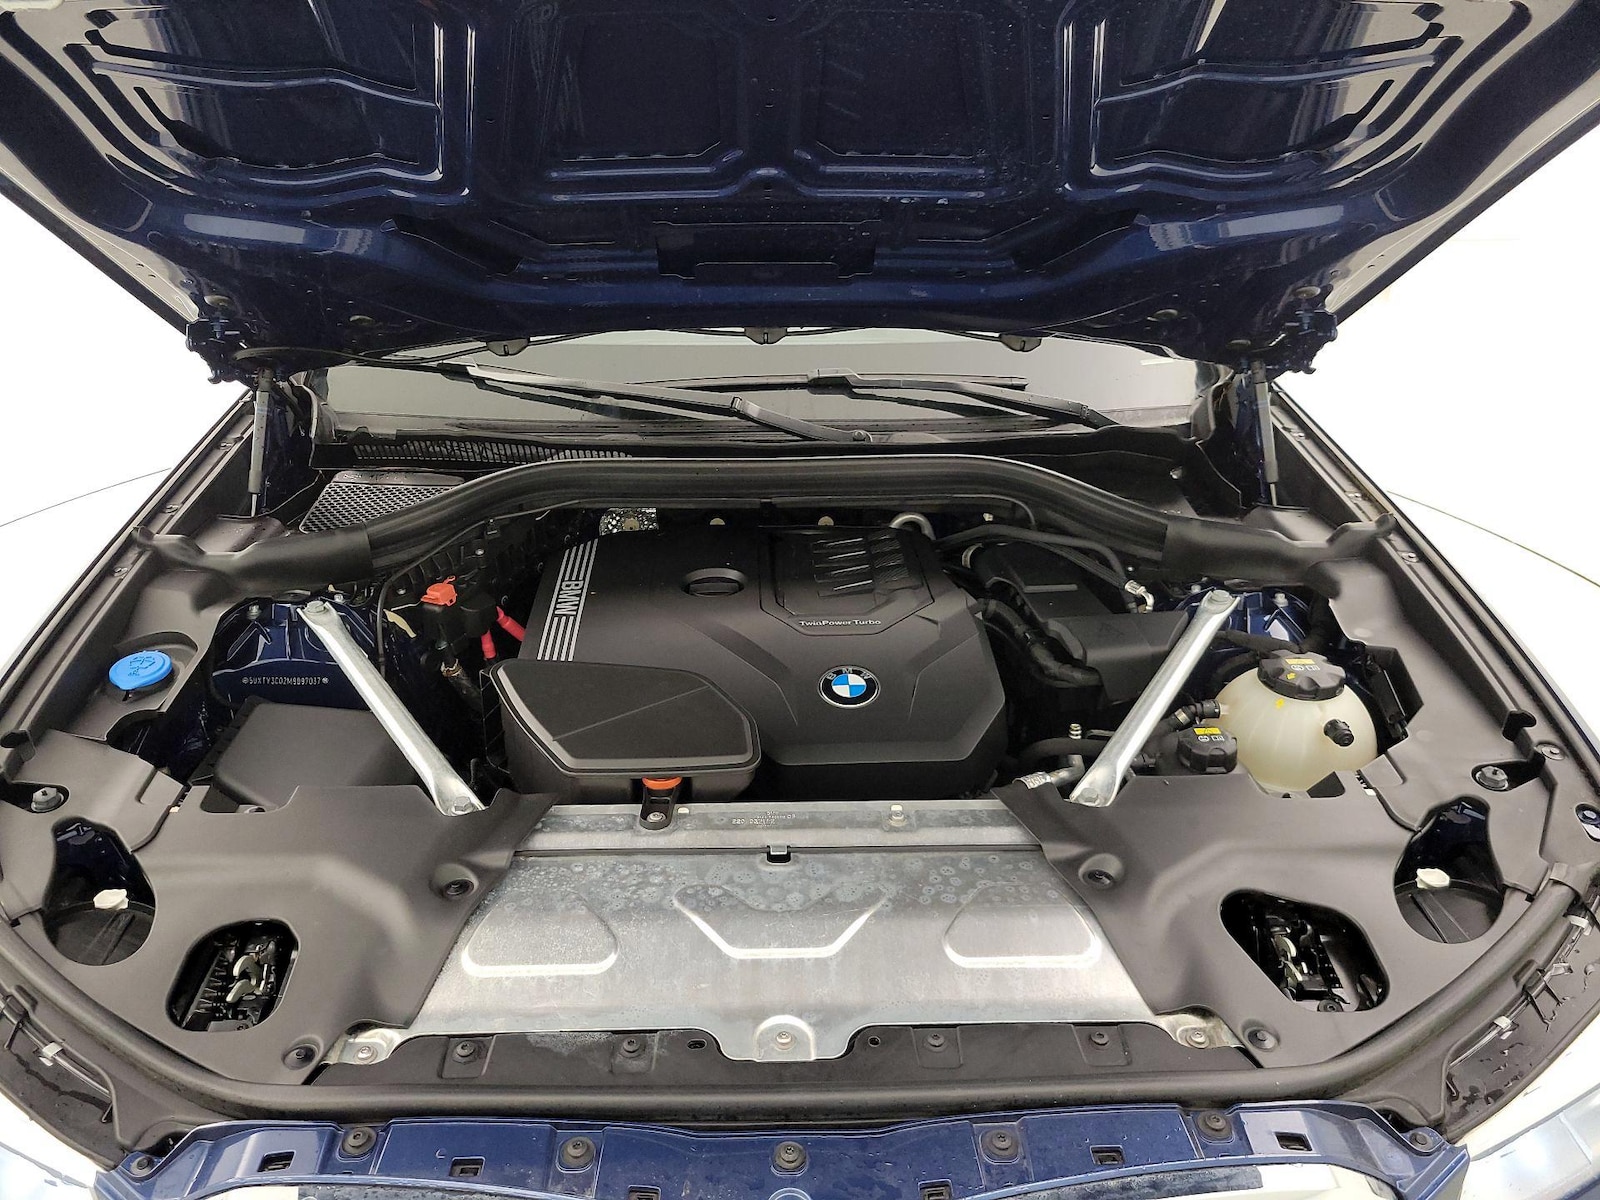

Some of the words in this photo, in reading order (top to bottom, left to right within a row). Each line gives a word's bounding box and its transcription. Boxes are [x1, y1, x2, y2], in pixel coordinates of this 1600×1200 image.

[554, 580, 584, 615] BMW
[799, 619, 852, 627] TwinPower
[826, 667, 872, 680] BMW
